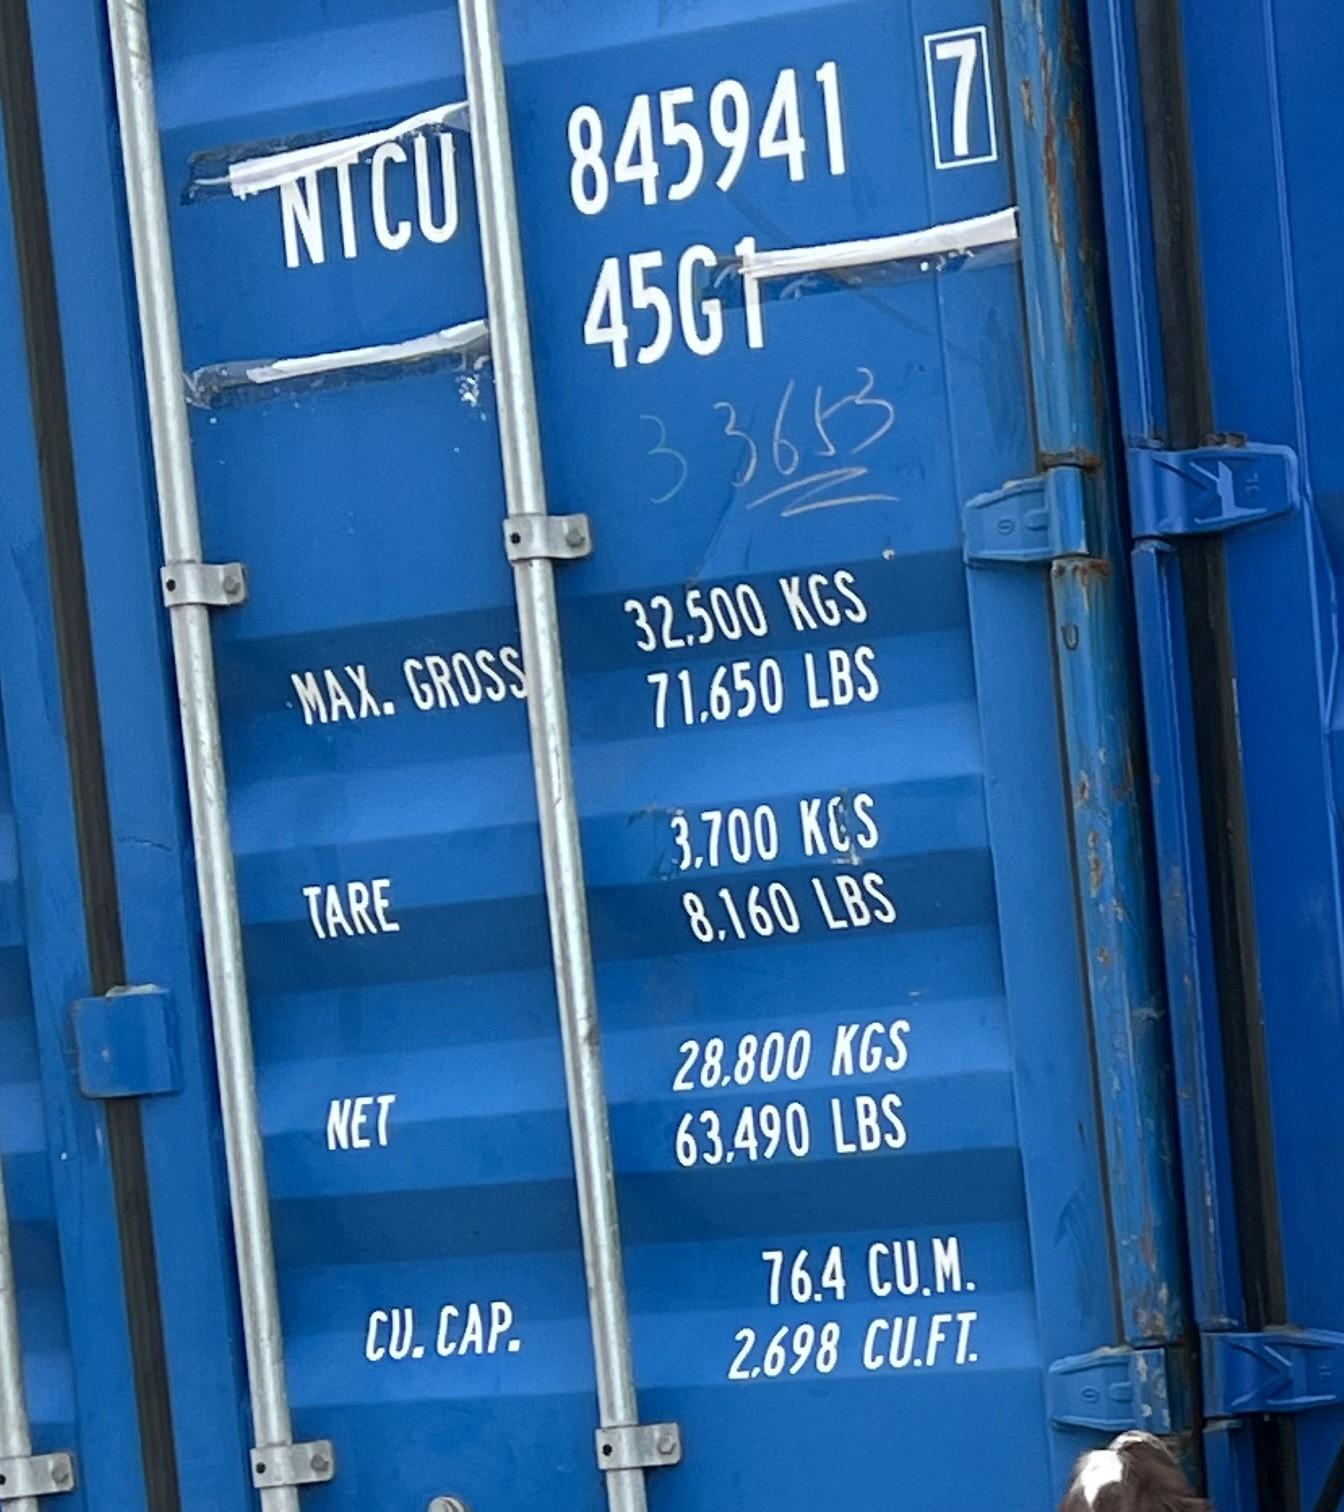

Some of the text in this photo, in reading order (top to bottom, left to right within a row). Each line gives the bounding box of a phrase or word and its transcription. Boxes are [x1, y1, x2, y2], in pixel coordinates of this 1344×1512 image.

[280, 38, 977, 268] NTCU 845941 7
[584, 236, 764, 368] 45G1
[778, 570, 867, 631] KGS
[291, 646, 529, 725] MAX. GROSS
[647, 646, 879, 728] 71,650 LBS
[671, 805, 778, 870] 3,700
[303, 879, 400, 939] TARE
[683, 872, 896, 942] 8,160 LBS
[672, 1020, 910, 1091] 28,800 KGS
[327, 1094, 396, 1150] NET
[676, 1093, 906, 1167] 63,490 LBS
[762, 1237, 975, 1305] 76.4 CU.M.
[366, 1301, 521, 1361] CU. CAP.
[728, 1311, 978, 1379] 2,698 CU.FT.
